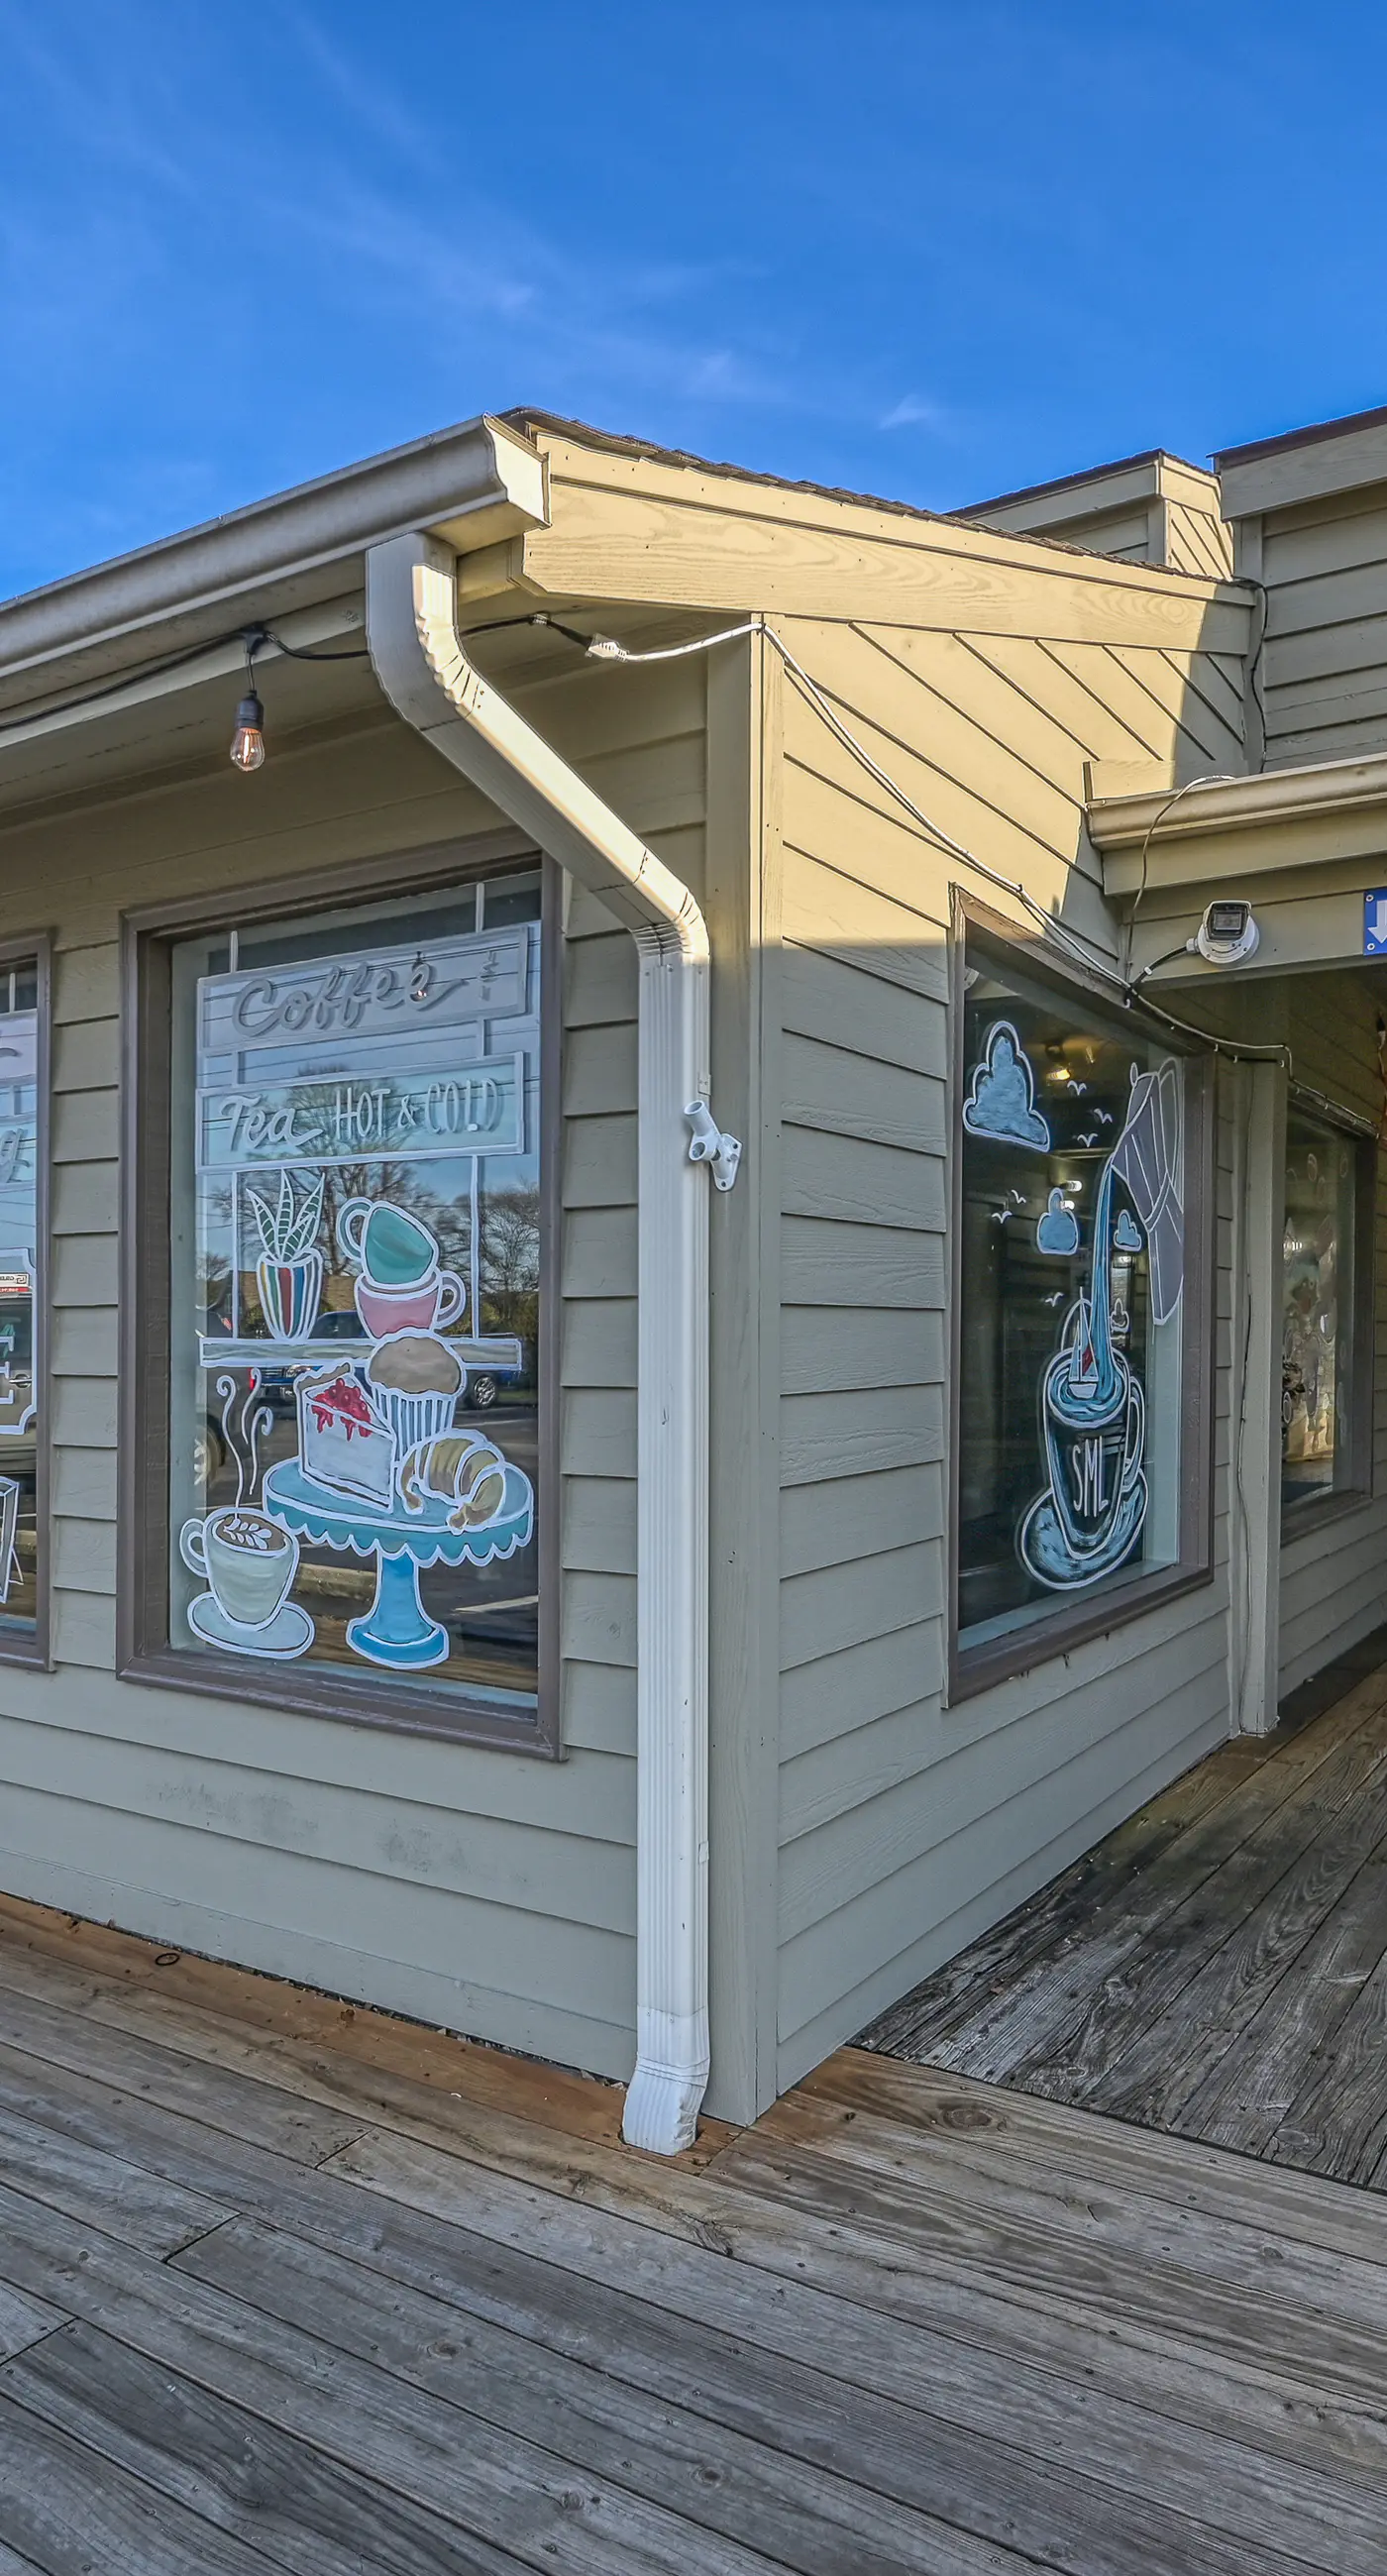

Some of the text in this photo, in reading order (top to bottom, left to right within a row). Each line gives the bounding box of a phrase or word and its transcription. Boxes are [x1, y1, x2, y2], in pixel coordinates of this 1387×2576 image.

[233, 963, 468, 1036] Coffee
[219, 1077, 499, 1151] Tea HOT & COLD
